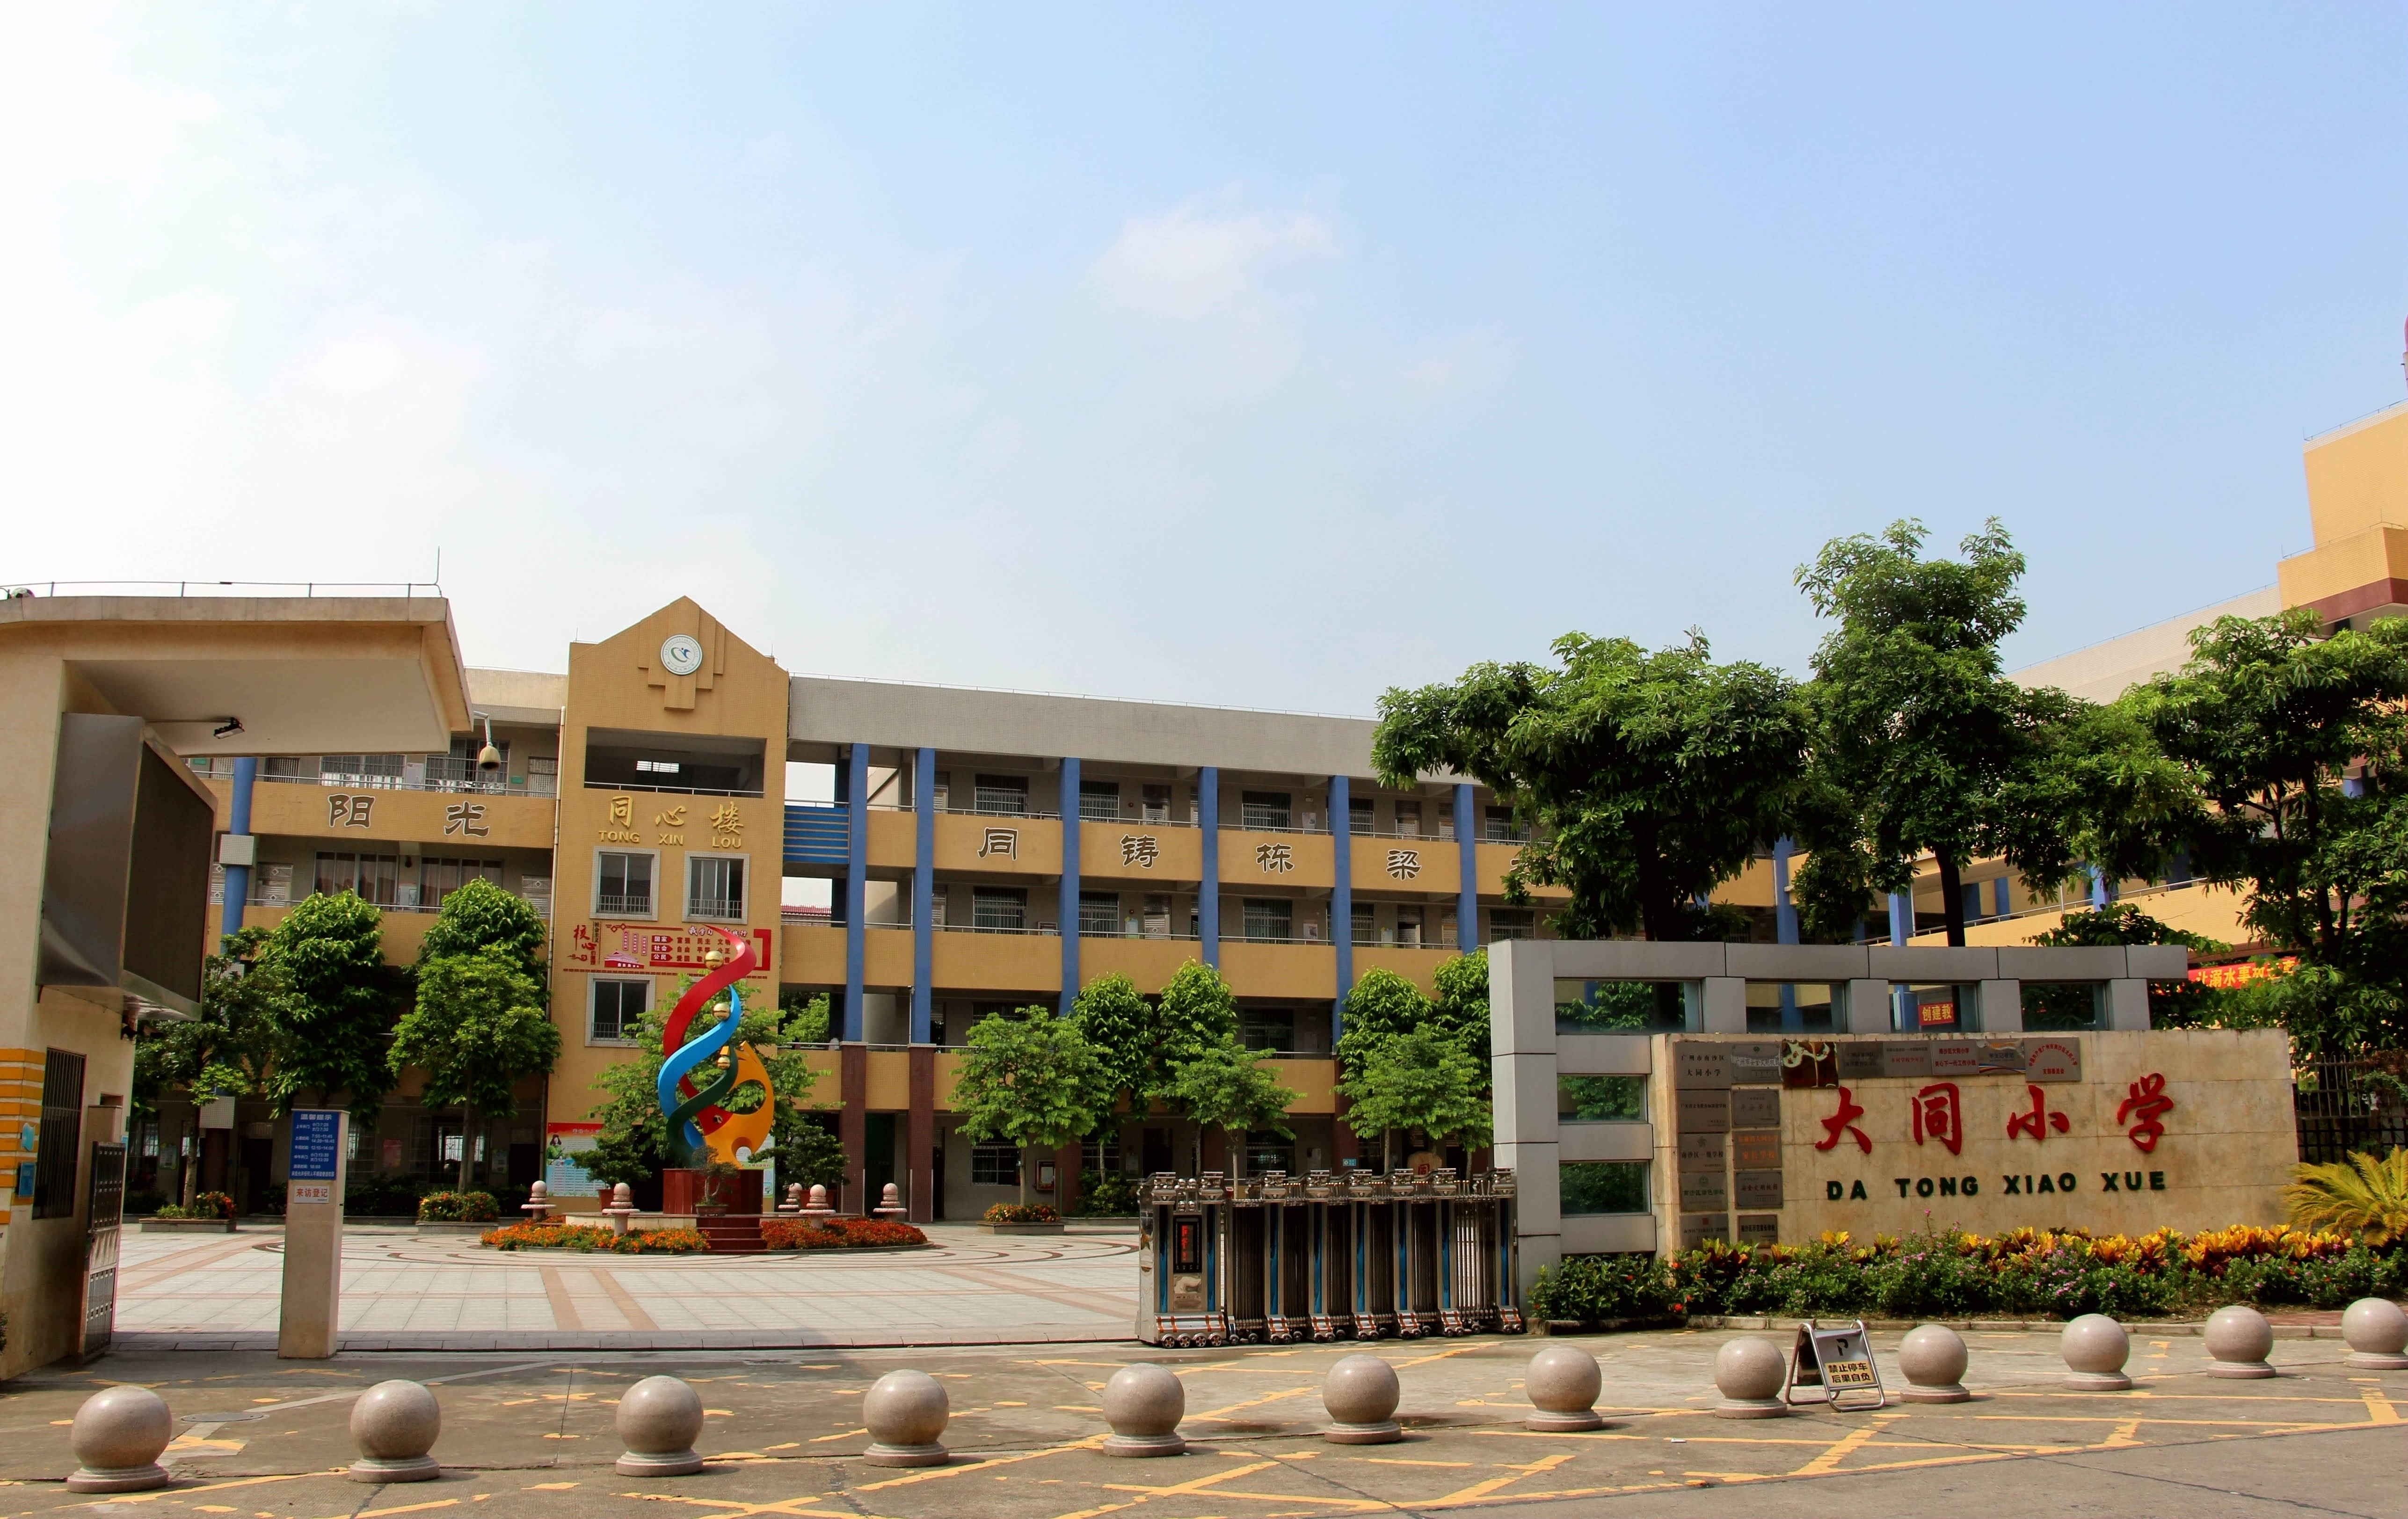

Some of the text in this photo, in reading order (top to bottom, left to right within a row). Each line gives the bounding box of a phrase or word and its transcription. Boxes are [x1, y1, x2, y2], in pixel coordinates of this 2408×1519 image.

[328, 793, 490, 837] 阳光
[610, 796, 744, 835] 同心楼
[599, 830, 742, 848] TONG XIN LOU
[574, 924, 597, 951] 核心
[689, 926, 713, 936] 我学习
[1815, 1072, 2174, 1155] 大同小学
[297, 1188, 327, 1198] 来访登记
[1826, 1170, 2166, 1200] DA TONG XIAO XUE
[1827, 1362, 1868, 1373] 禁止停车
[1831, 1373, 1871, 1383] 后果自负
